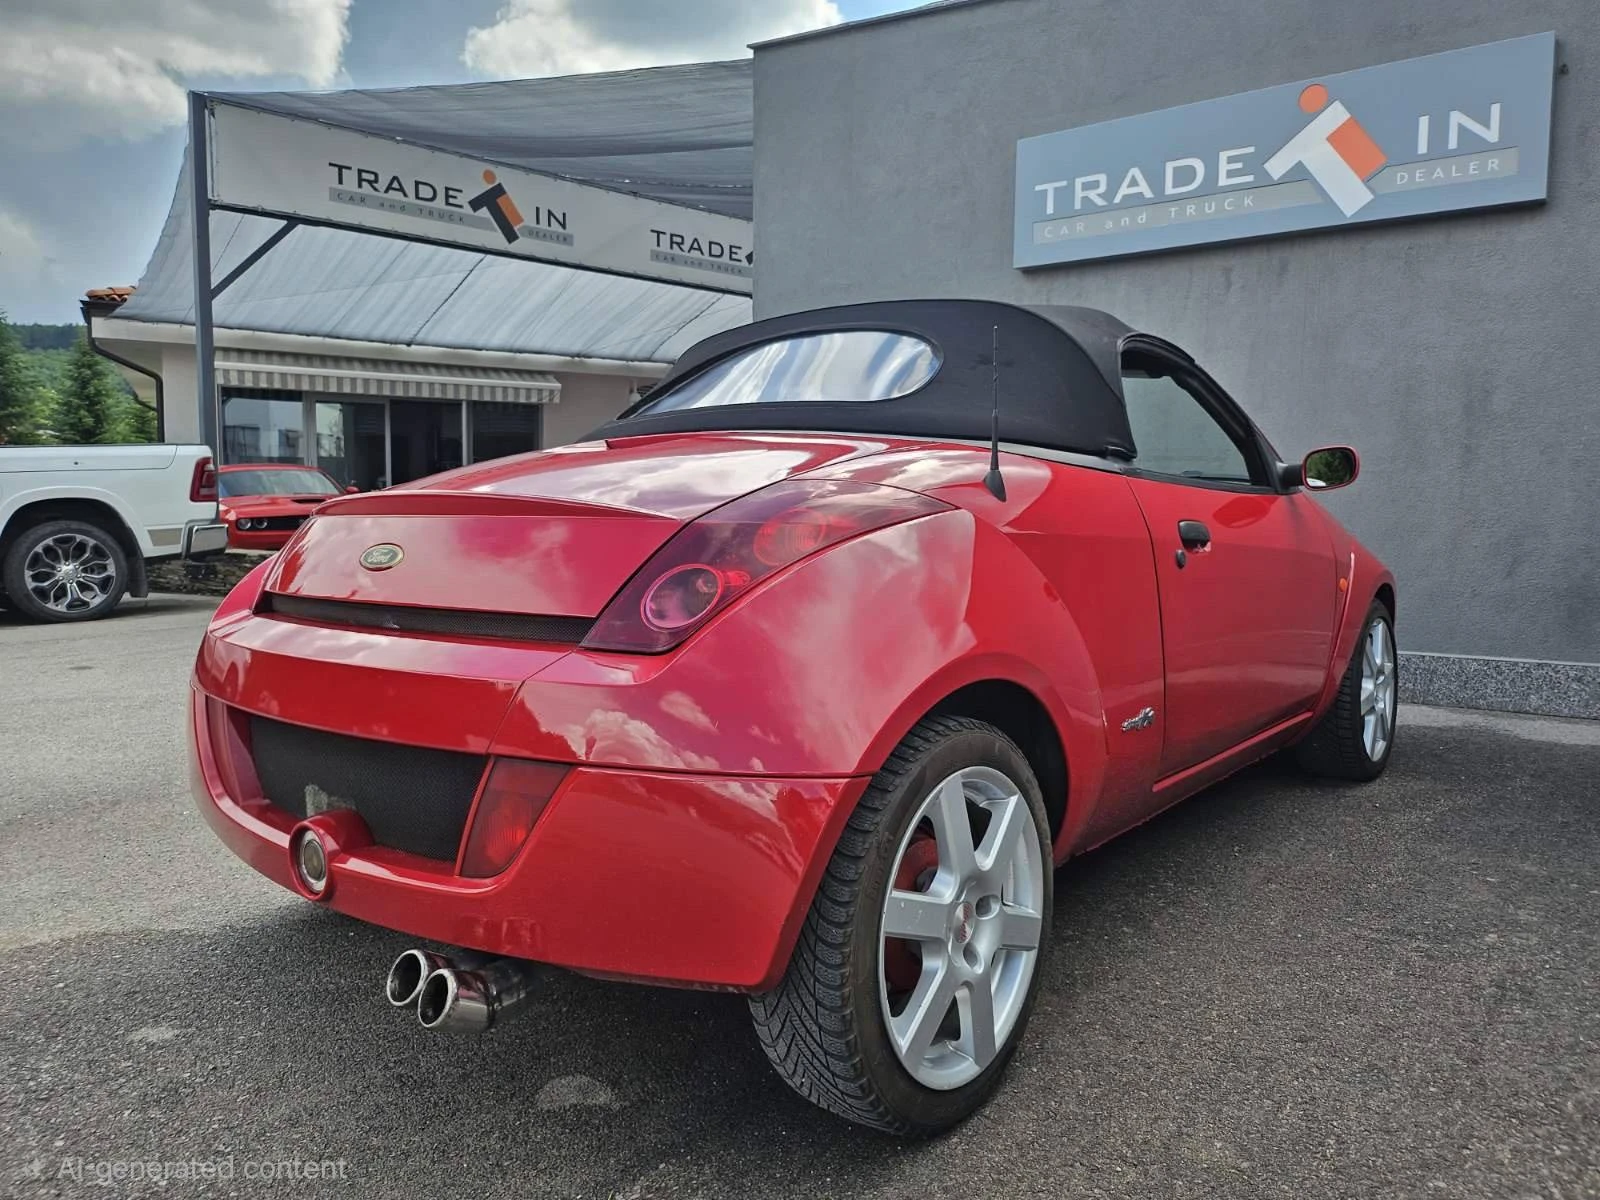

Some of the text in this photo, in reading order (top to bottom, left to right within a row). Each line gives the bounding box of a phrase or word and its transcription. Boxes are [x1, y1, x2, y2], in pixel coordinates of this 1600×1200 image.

[1034, 146, 1256, 215] TRADE
[1416, 102, 1501, 155] IN
[328, 162, 464, 209] TRADE
[535, 206, 567, 231] IN
[336, 192, 569, 243] CAR and TRUCK DEALER
[1044, 158, 1500, 239] CAR and TRUCK DEALER
[649, 229, 743, 263] TRADE
